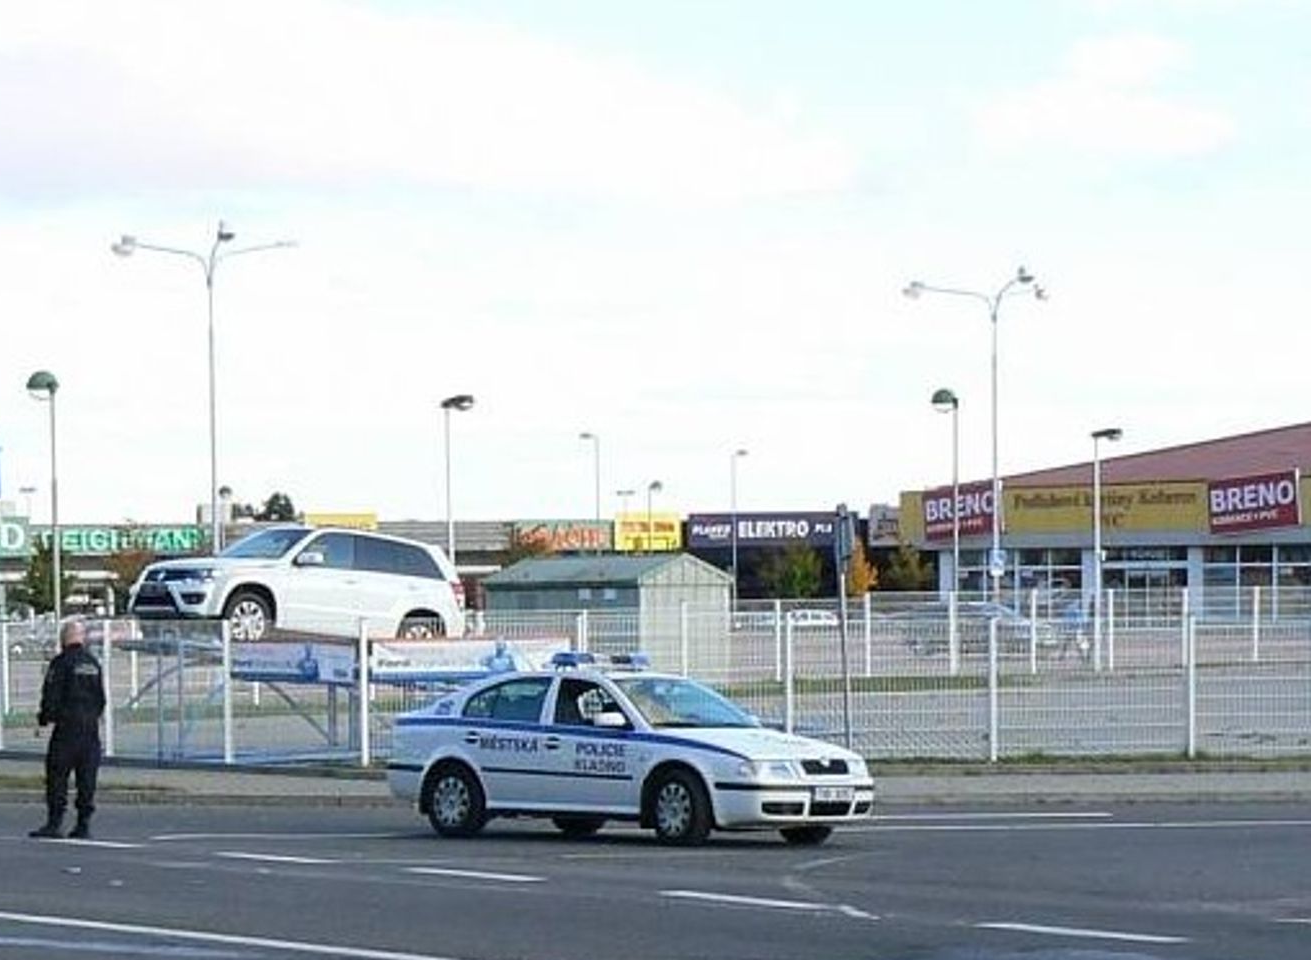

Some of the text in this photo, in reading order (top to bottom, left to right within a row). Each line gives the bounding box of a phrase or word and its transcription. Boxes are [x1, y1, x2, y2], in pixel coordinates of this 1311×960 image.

[1210, 479, 1295, 513] BRENO
[0, 523, 25, 550] D
[738, 520, 810, 539] ELEKTRO
[575, 743, 627, 757] POLICIE
